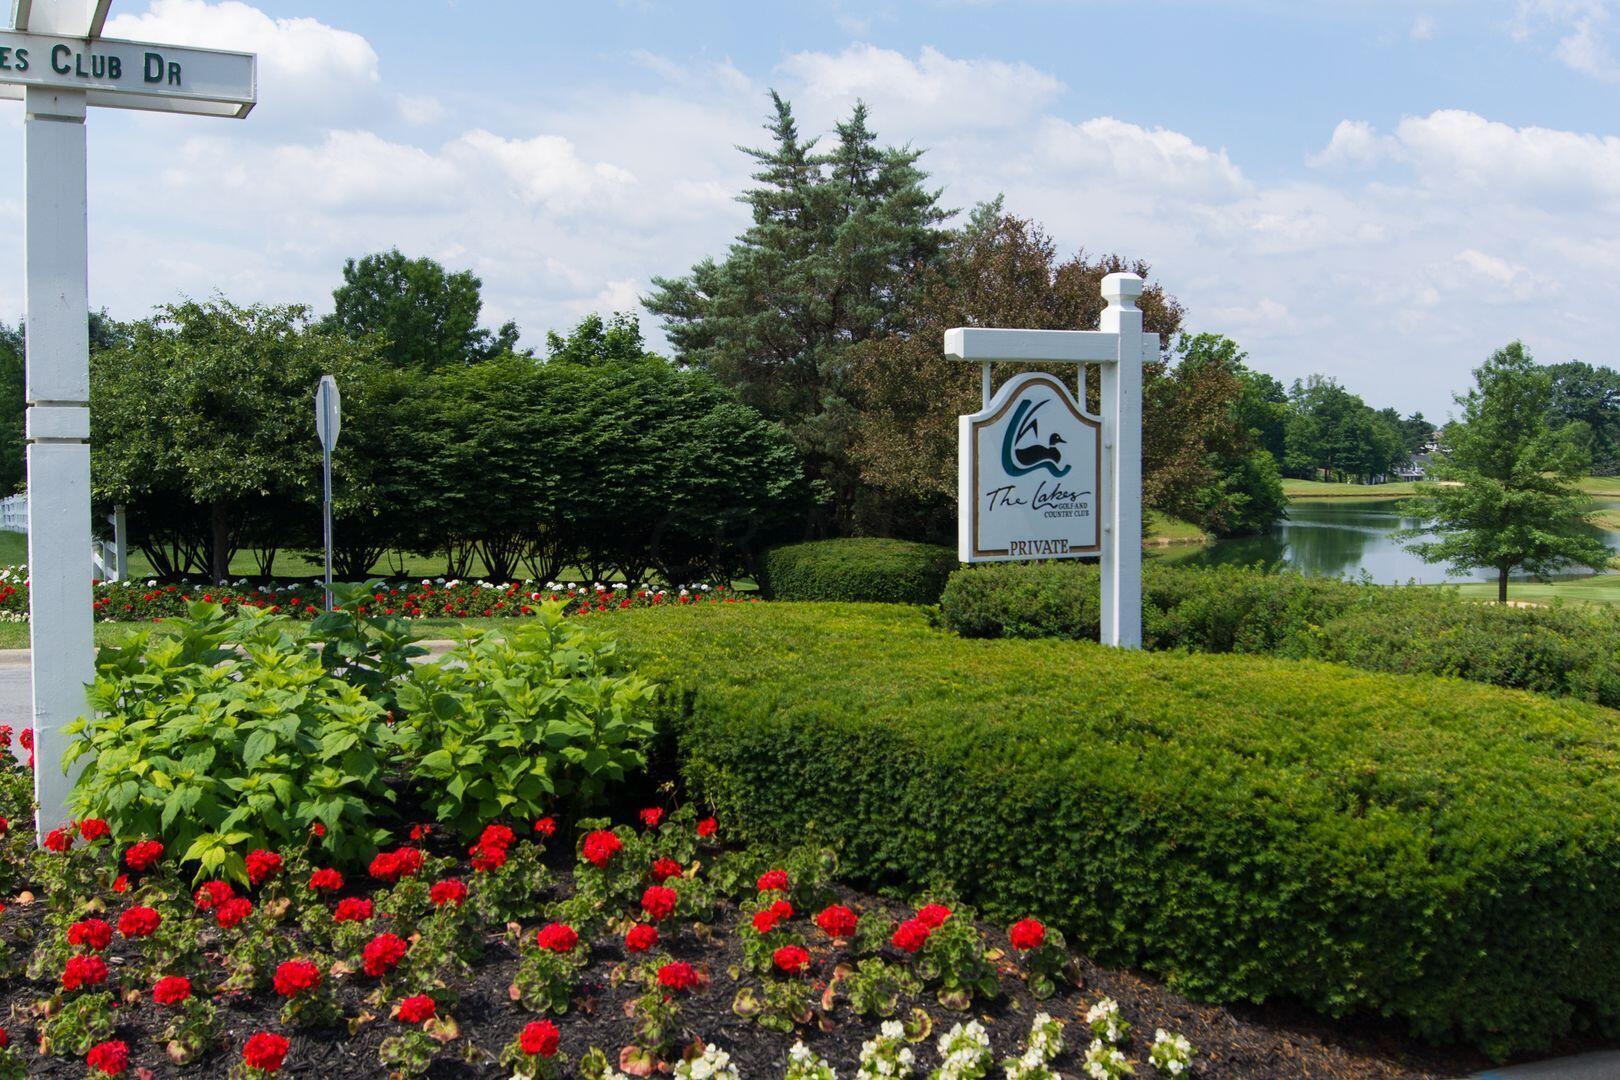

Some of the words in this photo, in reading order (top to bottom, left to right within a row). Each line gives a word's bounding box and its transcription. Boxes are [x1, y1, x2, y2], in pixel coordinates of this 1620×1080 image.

[986, 485, 1028, 511] The
[1032, 480, 1091, 510] Lakes
[1010, 539, 1069, 556] PRIVATE
